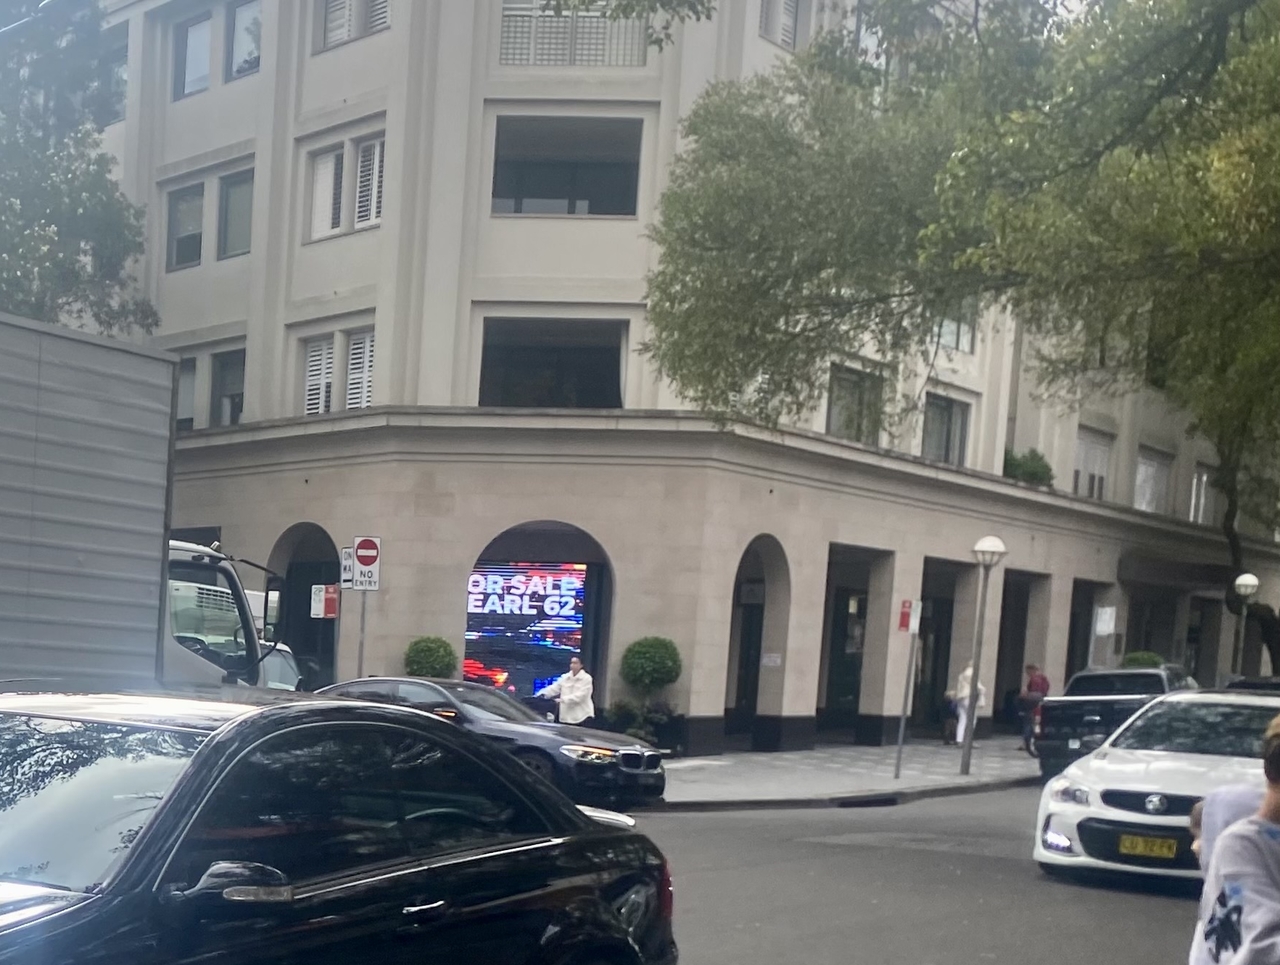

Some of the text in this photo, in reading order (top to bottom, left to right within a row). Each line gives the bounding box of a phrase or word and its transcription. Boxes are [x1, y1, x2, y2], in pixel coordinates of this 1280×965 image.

[360, 570, 373, 579] NO
[354, 579, 377, 587] ENTRY
[467, 574, 580, 595] OR SALE
[467, 594, 576, 616] EARL 62
